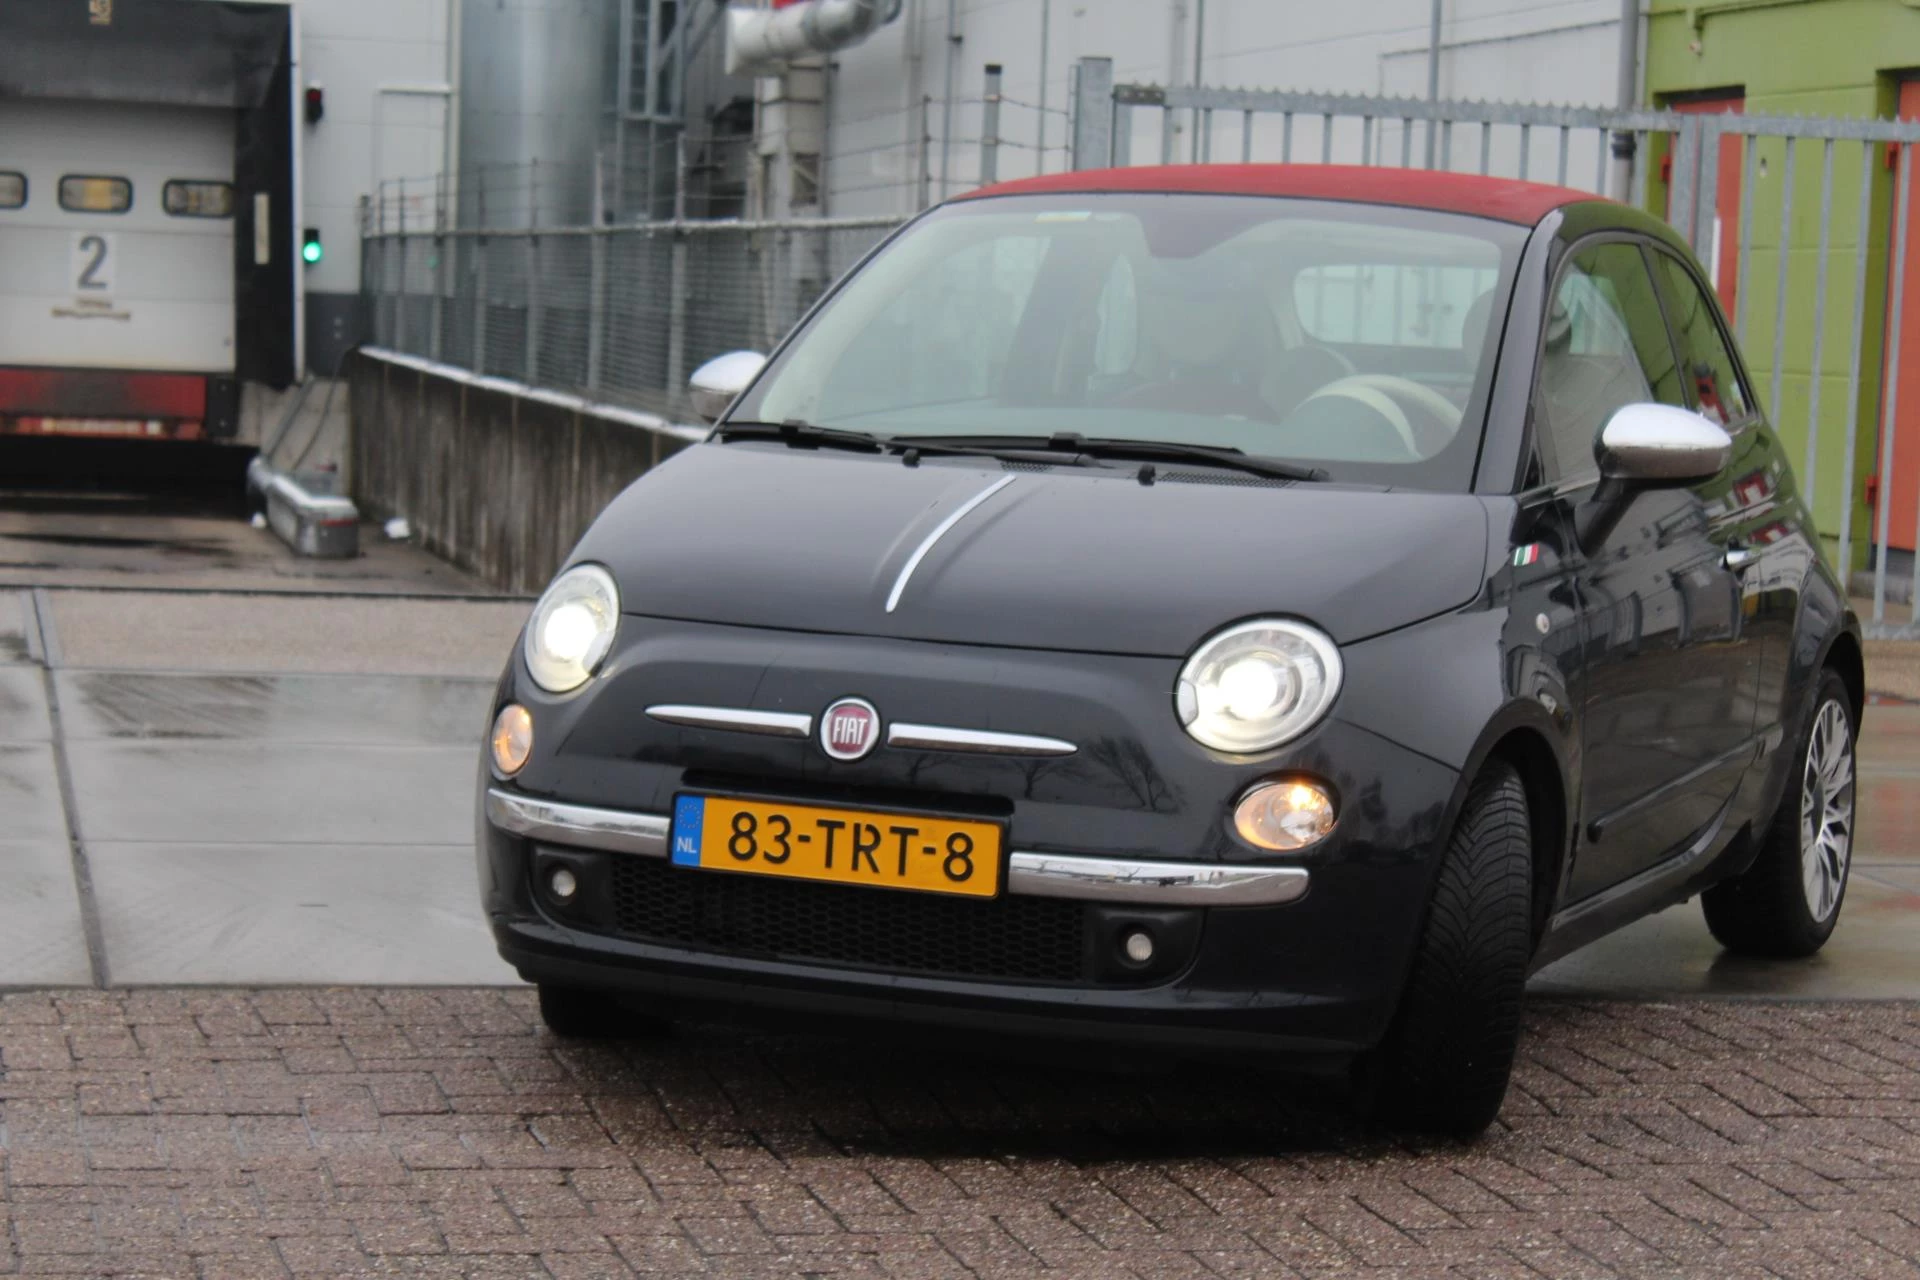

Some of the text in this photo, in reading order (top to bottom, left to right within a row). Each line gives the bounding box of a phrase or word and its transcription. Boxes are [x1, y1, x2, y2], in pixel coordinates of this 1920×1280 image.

[78, 235, 107, 290] 2
[832, 716, 868, 745] FIAT
[676, 811, 974, 882] NL 83-TRT-8
